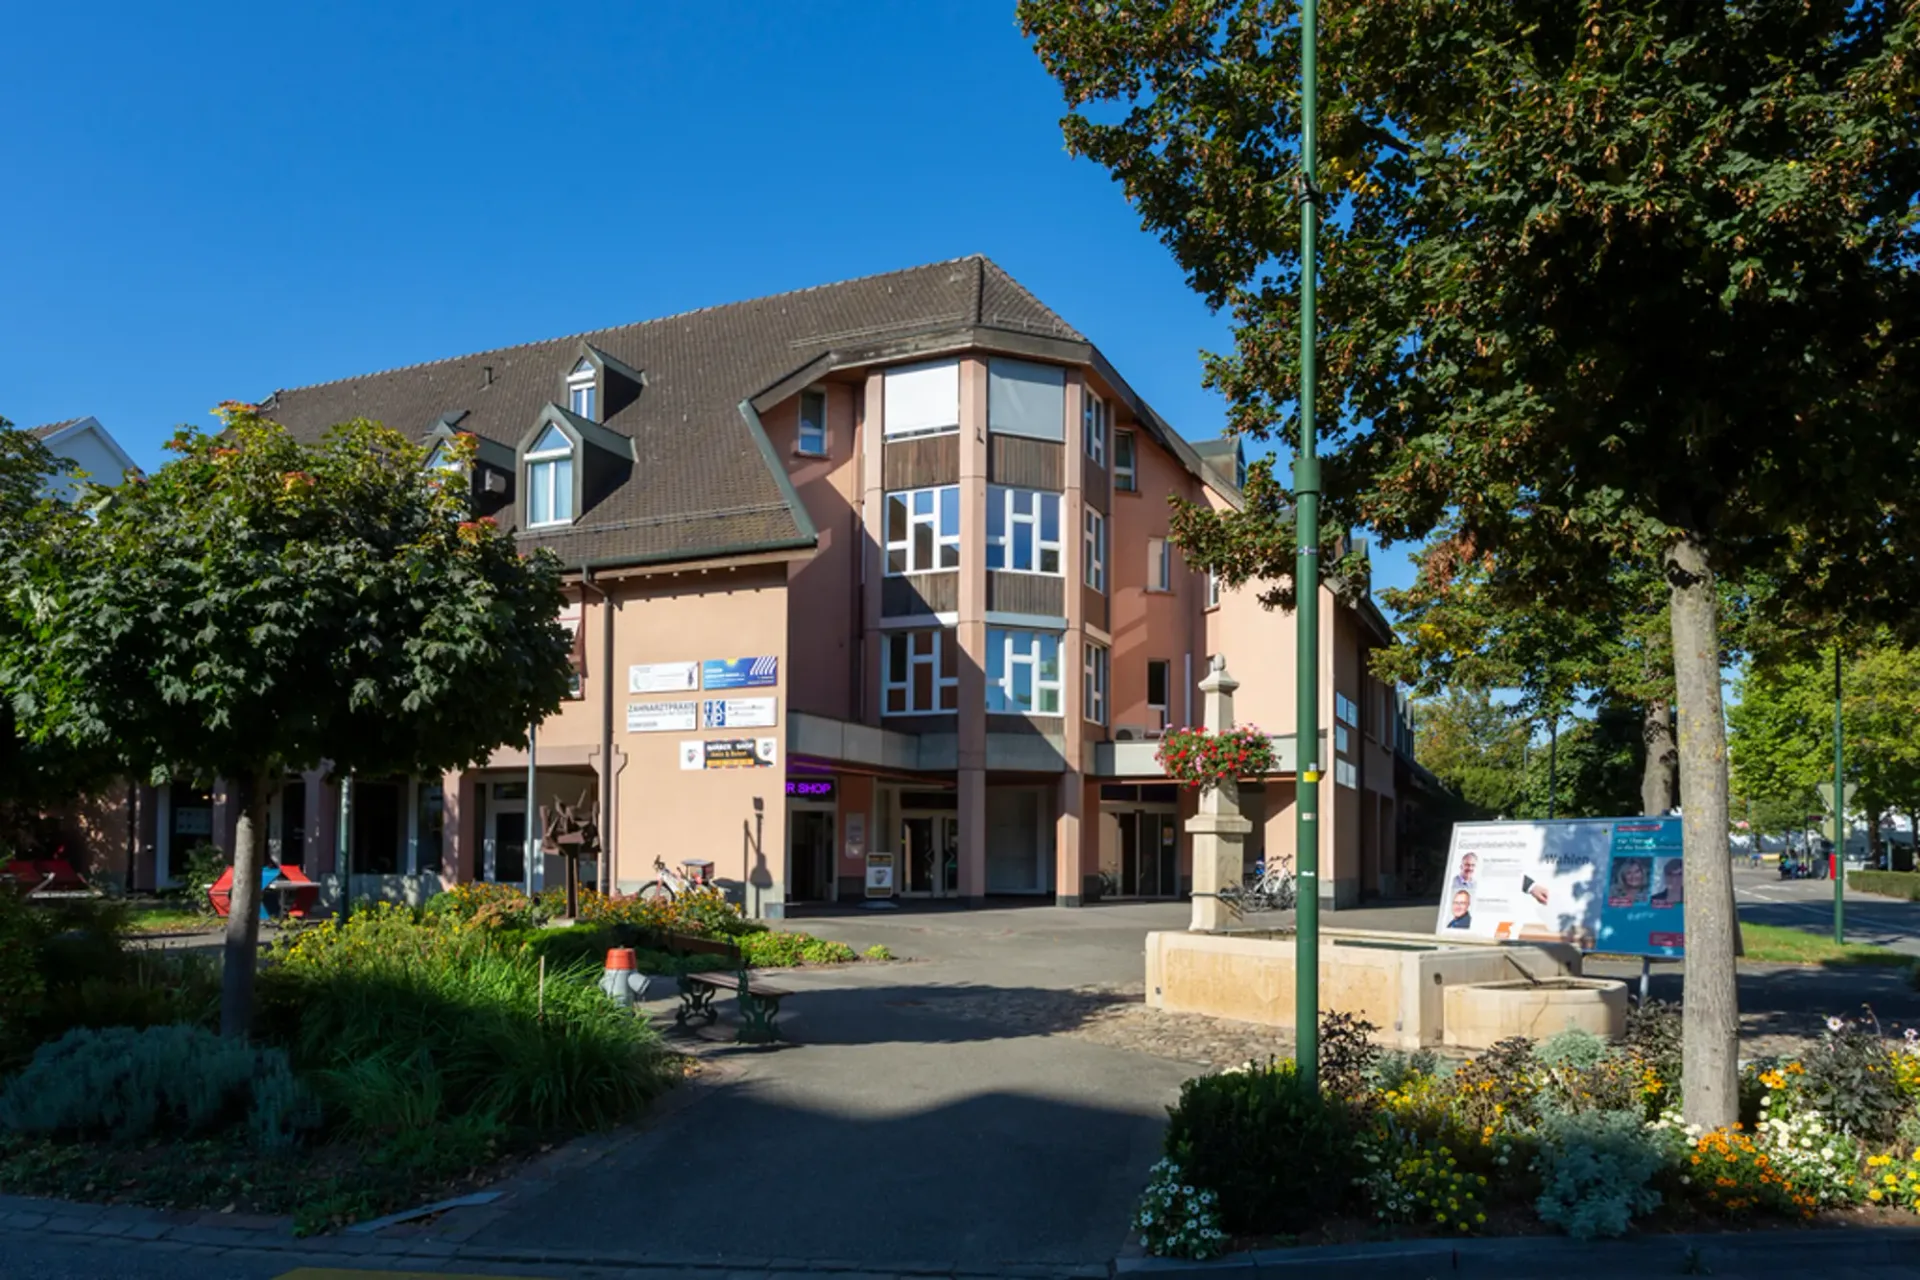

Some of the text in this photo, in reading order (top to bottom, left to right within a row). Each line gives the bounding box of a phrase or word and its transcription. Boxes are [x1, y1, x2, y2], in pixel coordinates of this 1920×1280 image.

[628, 702, 695, 712] ZAHNARZTPRAXIS
[797, 782, 832, 794] SHOP
[1544, 853, 1590, 865] Wahlen
